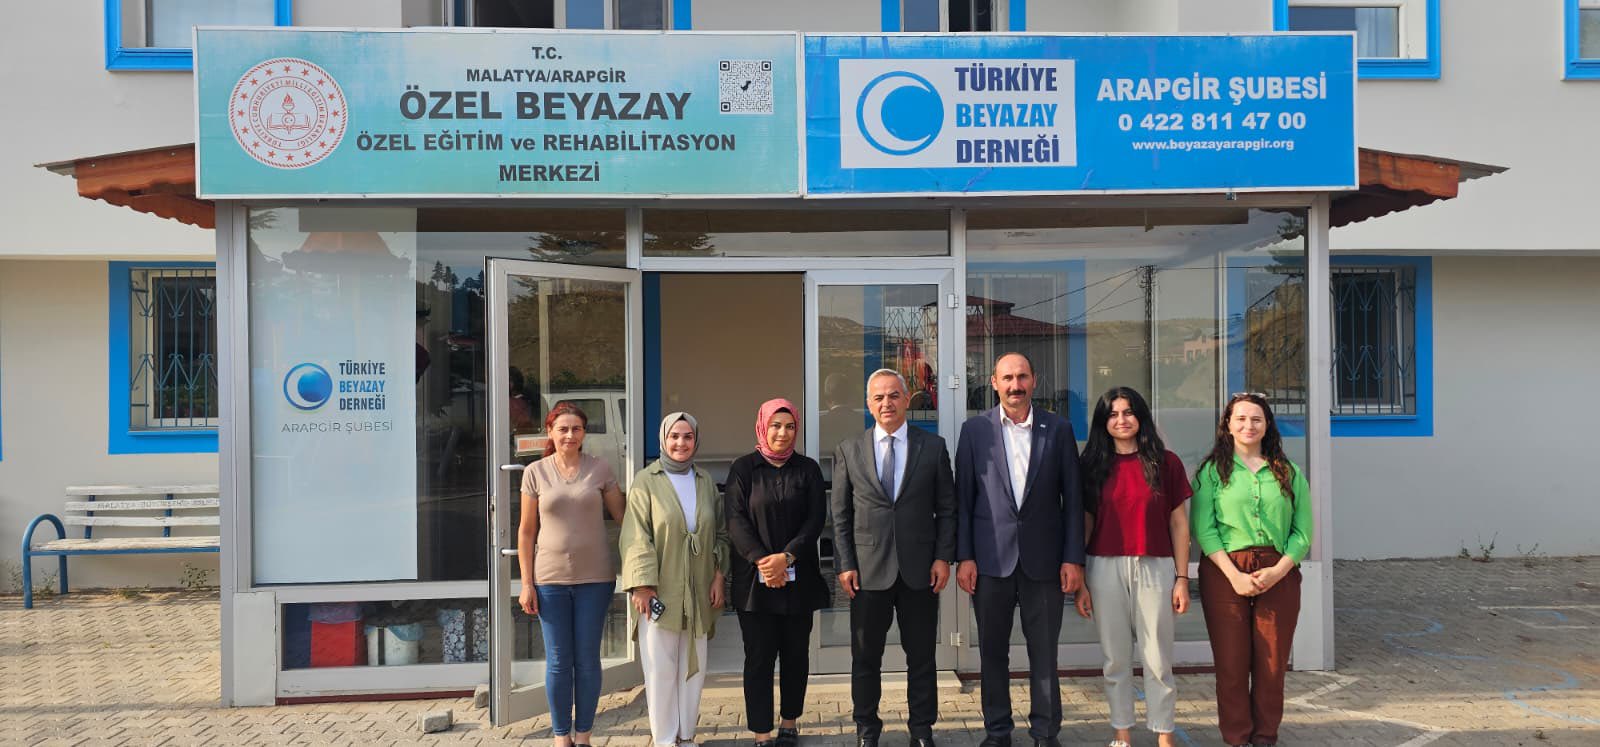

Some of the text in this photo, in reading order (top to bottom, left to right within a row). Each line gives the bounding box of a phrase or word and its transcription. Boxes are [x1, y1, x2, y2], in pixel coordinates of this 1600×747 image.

[532, 46, 563, 60] T.C.
[466, 67, 626, 83] MALATYA/ARAPGİR
[954, 63, 1058, 92] TÜRKİYE
[1096, 71, 1327, 105] ARAPGİR ŞUBESİ
[400, 85, 692, 120] ÖZEL BEYAZAY
[956, 103, 1058, 128] BEYAZAY
[1118, 112, 1306, 131] 0 422 811 47 00
[356, 129, 736, 151] ÖZEL EĞİTİM ve REHABİLİTASYON
[956, 134, 1059, 163] DERNEĞİ
[1132, 138, 1295, 152] www.beyazayarapgir.org
[499, 161, 600, 182] MERKEZİ
[339, 360, 386, 375] TÜRKİYE
[339, 380, 386, 393] BEYAZAY
[339, 394, 386, 411] DERNEĞİ
[281, 420, 393, 434] ARAPGİR ŞUBESİ
